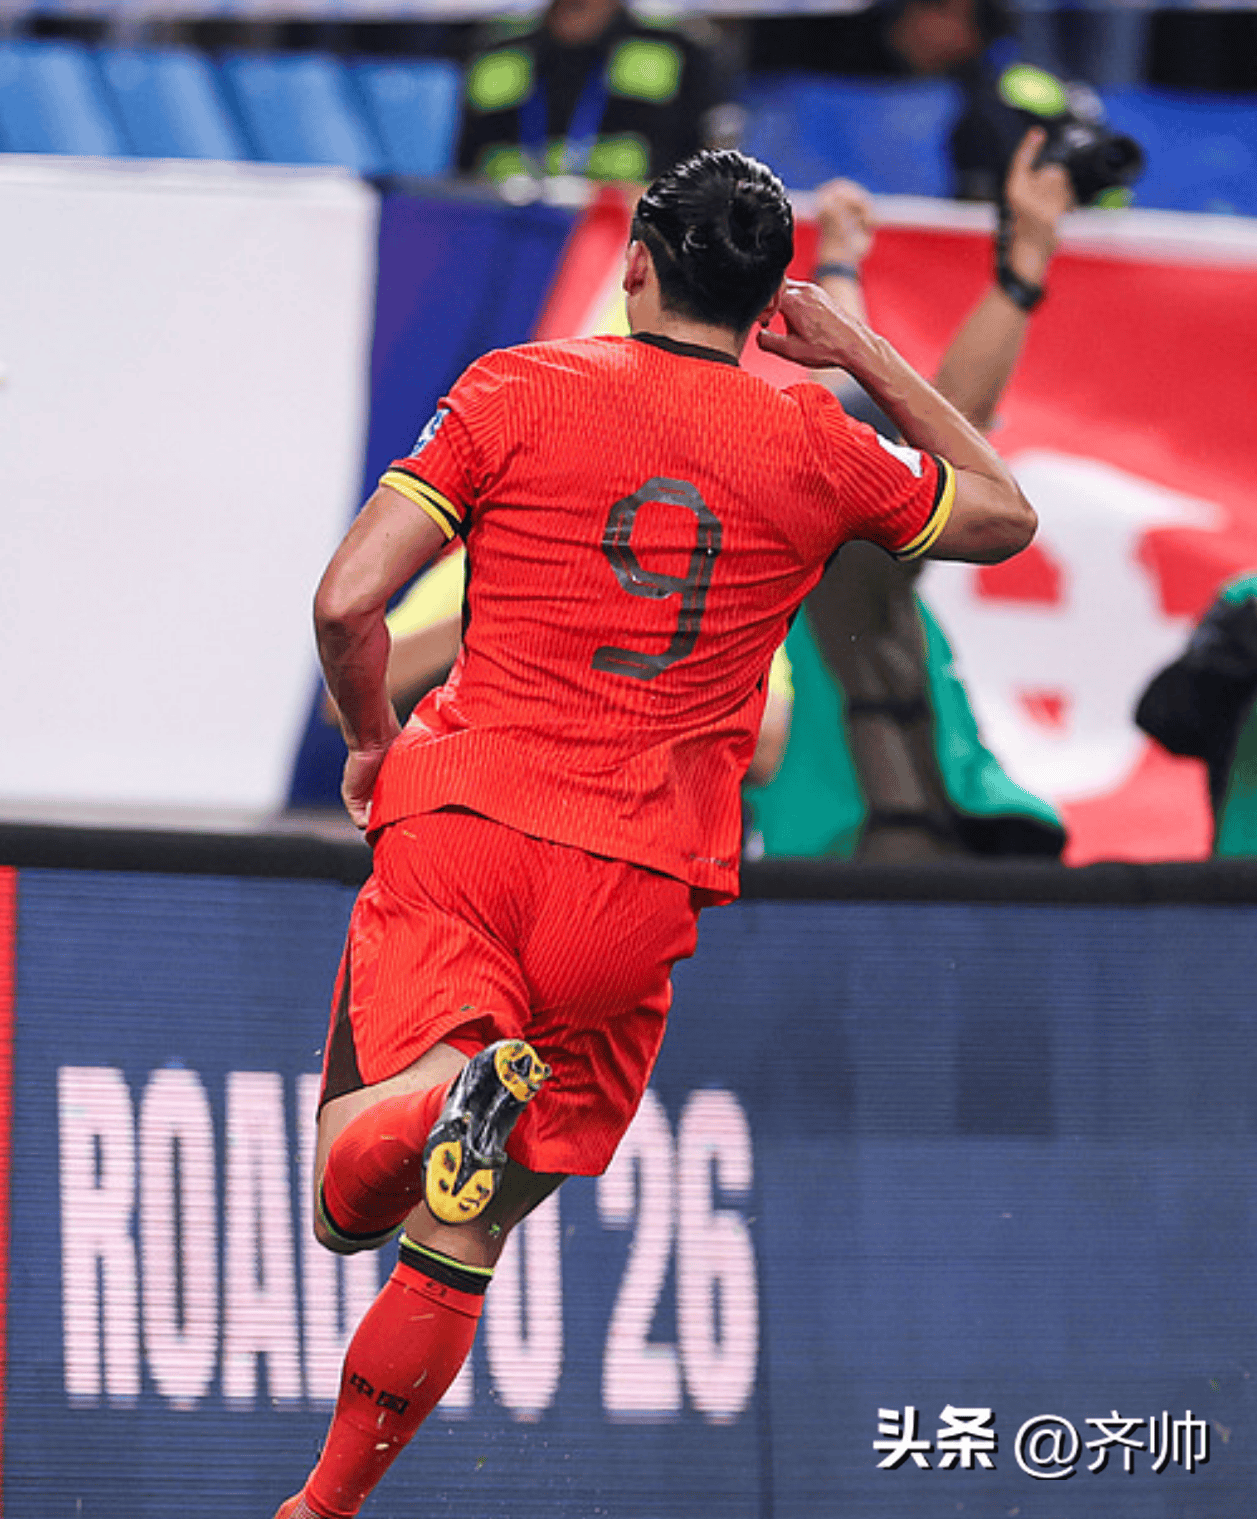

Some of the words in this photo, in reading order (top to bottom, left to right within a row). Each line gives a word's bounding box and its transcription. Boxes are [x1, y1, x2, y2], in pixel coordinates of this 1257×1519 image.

[591, 476, 723, 681] 9
[596, 1087, 760, 1414] 26
[350, 1372, 409, 1415] 中国
